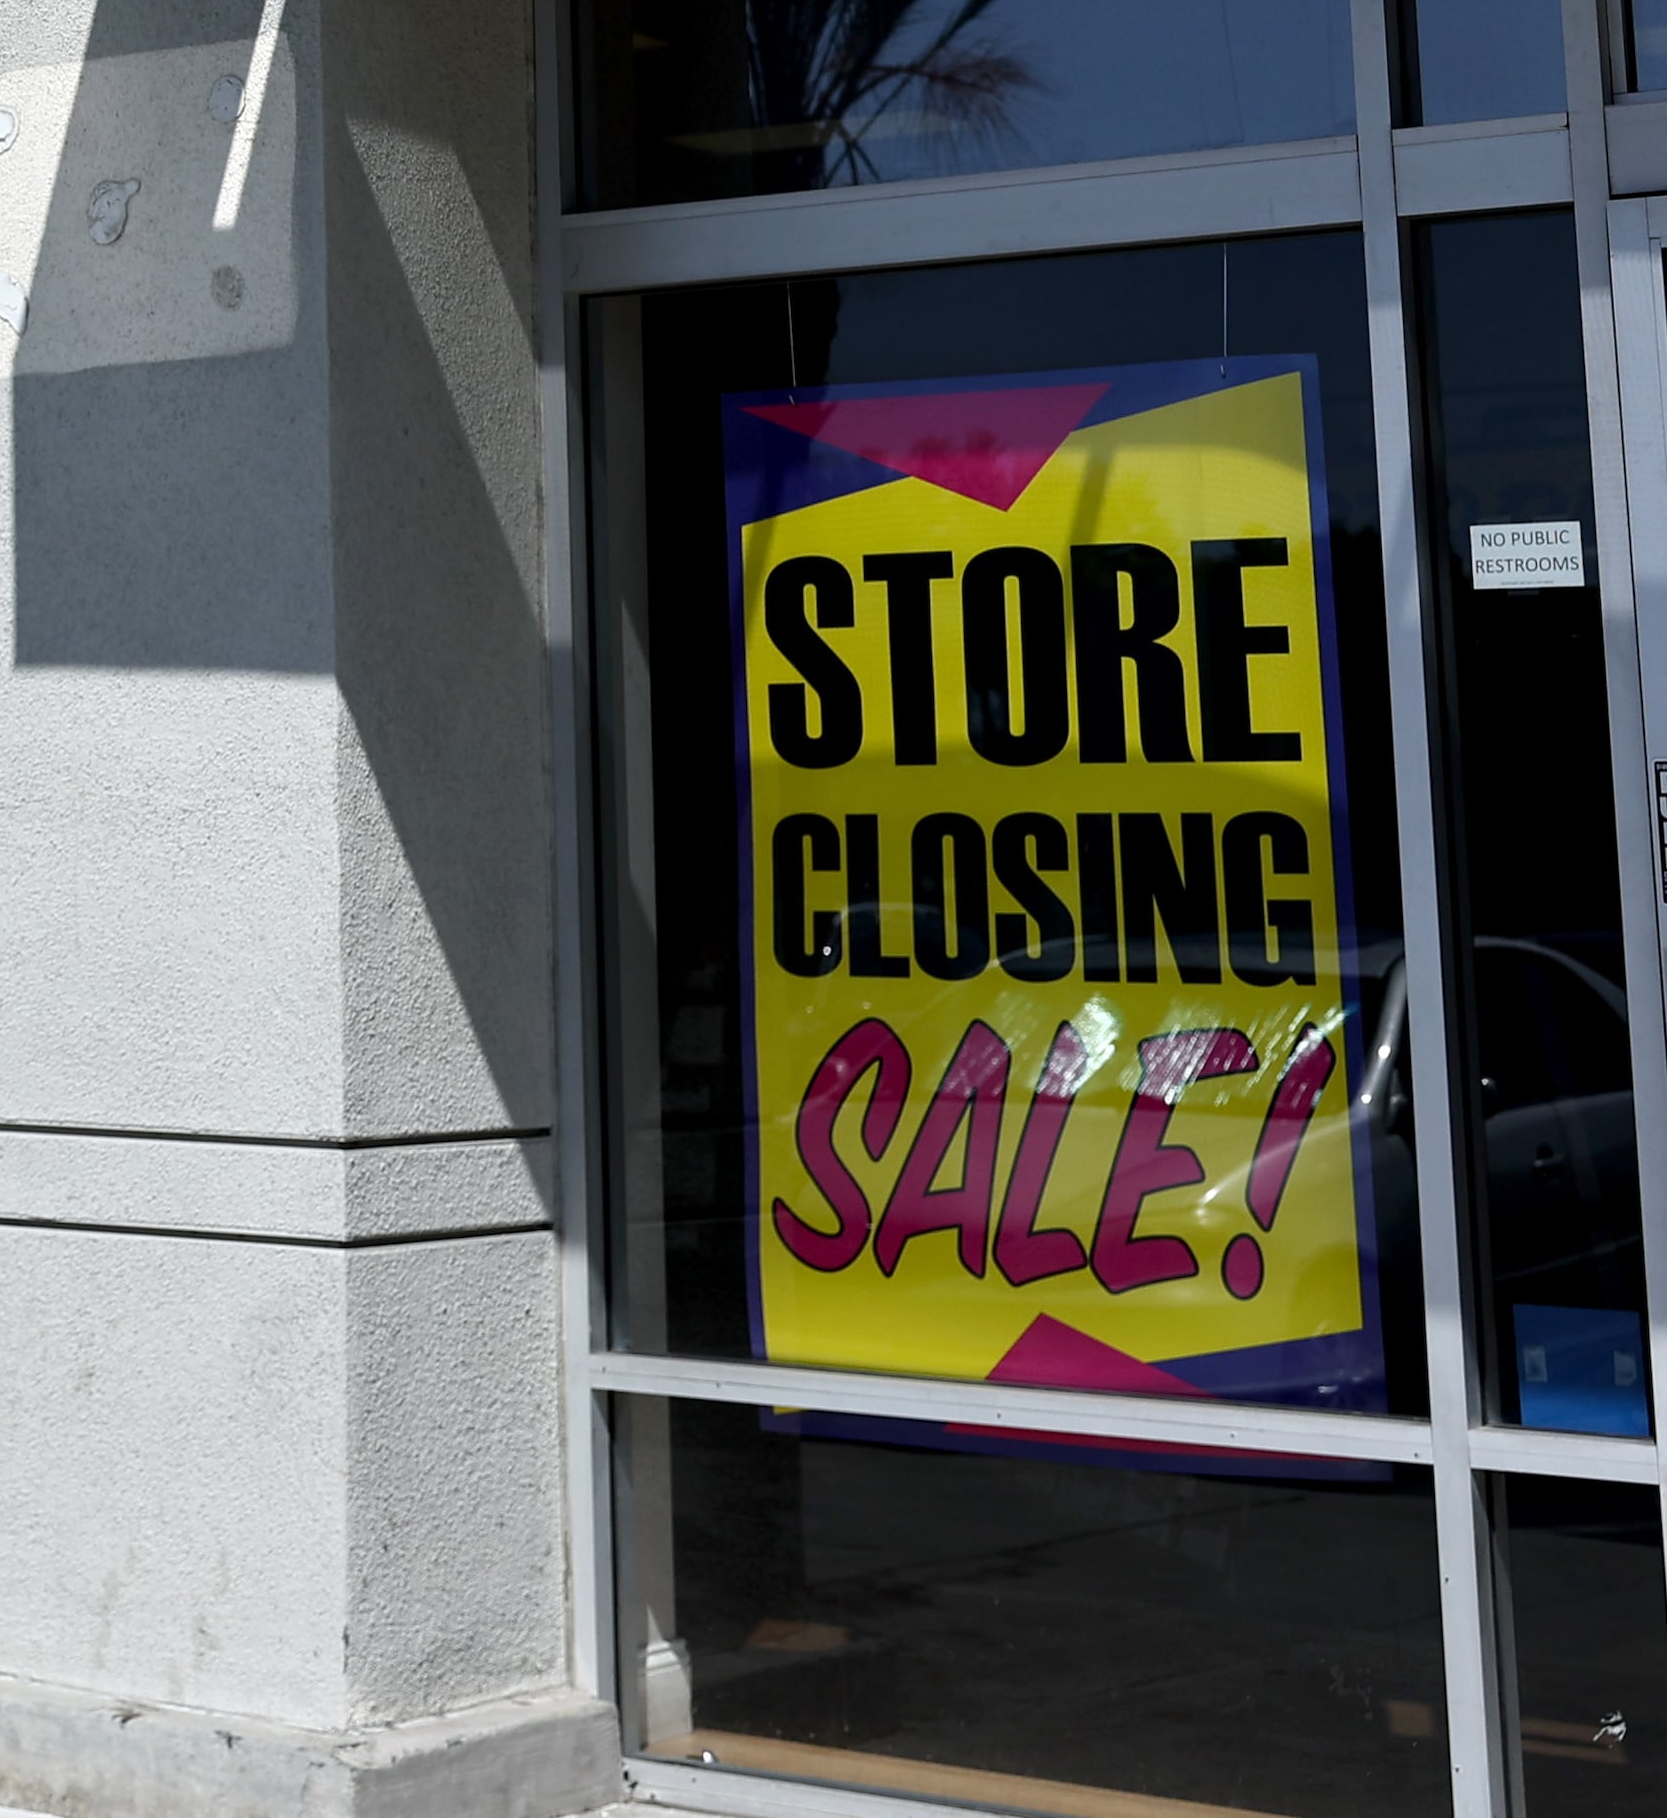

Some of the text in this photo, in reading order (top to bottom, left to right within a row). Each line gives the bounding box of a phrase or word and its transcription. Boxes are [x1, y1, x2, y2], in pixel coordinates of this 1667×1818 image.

[1475, 556, 1580, 575] RESTROOMS
[1480, 529, 1571, 548] NO PUBLIC
[764, 536, 1304, 771] STORE
[771, 811, 1317, 987] CLOSING
[772, 1016, 1337, 1302] SALE!
